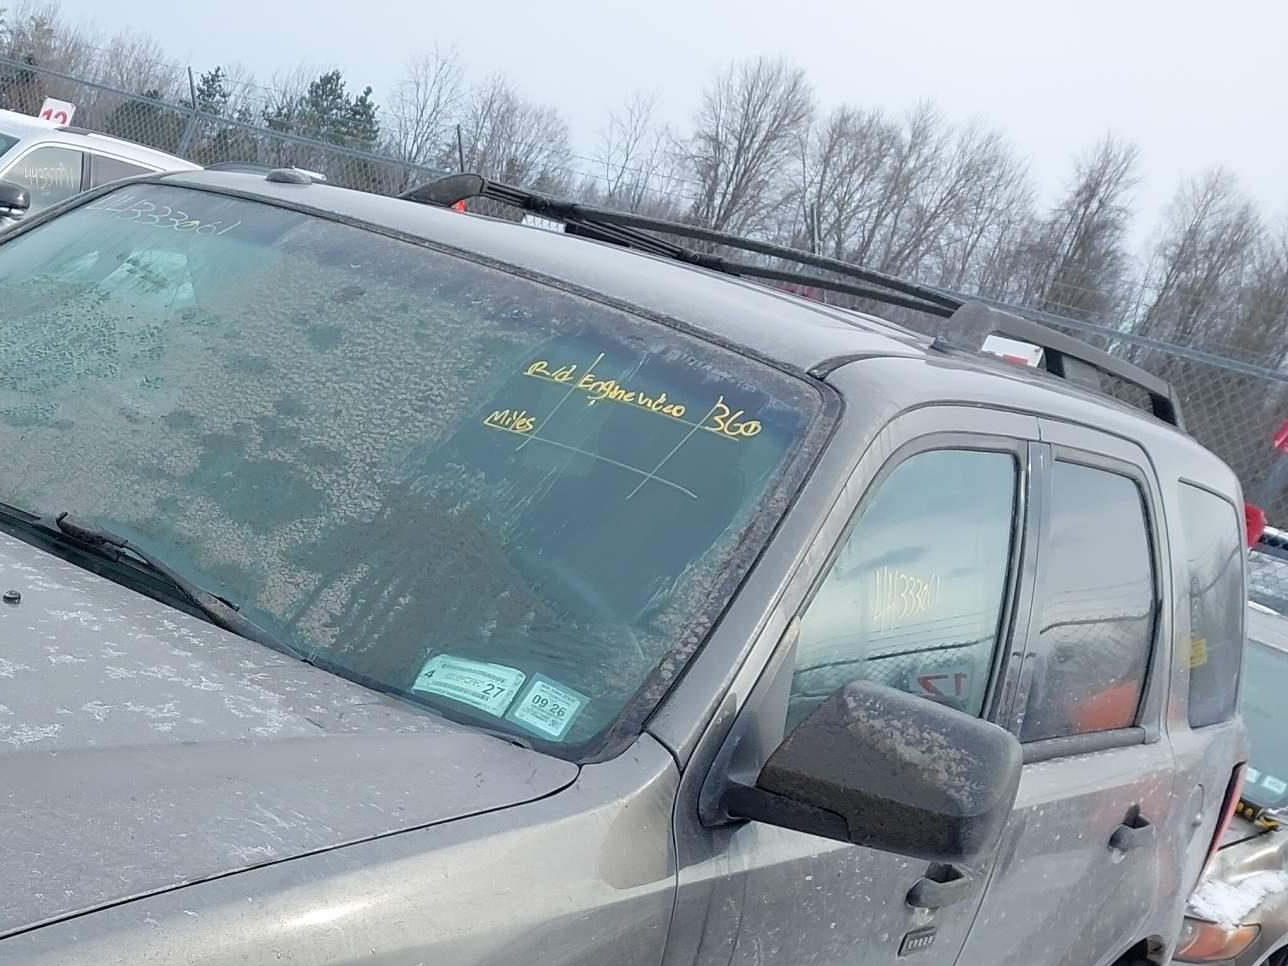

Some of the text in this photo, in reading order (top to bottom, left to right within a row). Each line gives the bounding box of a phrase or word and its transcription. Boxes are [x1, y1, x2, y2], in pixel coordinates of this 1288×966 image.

[705, 402, 762, 437] 360
[481, 683, 506, 699] 27
[531, 694, 549, 709] 09
[549, 702, 568, 718] 26
